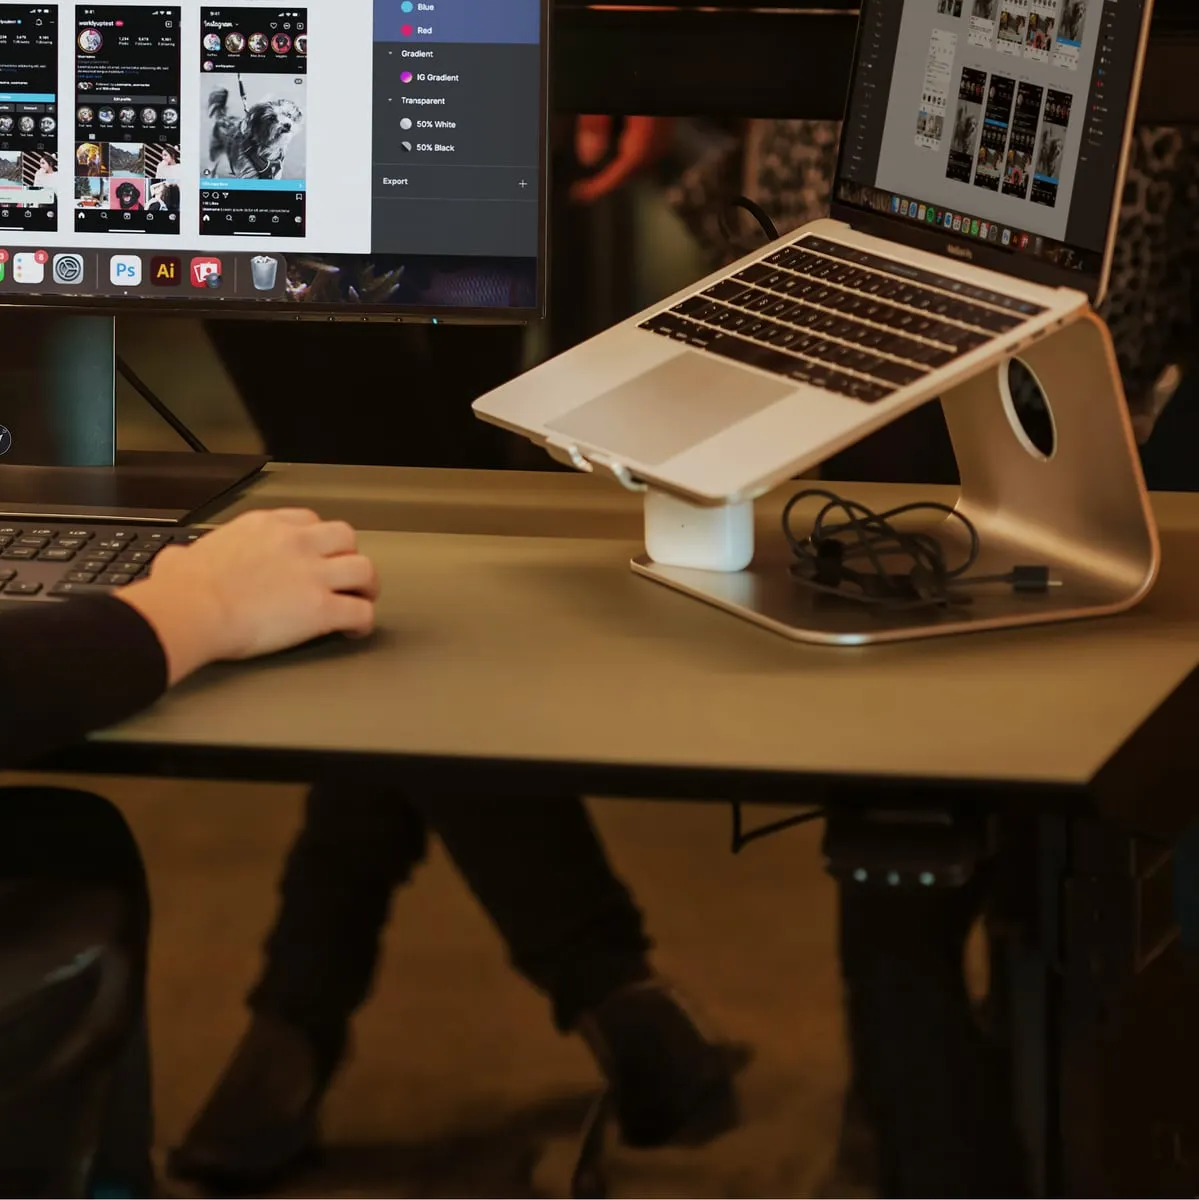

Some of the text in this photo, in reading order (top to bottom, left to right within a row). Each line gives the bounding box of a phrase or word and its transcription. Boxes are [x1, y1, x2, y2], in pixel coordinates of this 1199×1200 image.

[417, 3, 435, 11] Blue
[204, 20, 233, 29] Instagram
[417, 26, 433, 34] Red
[401, 50, 434, 58] Gradient
[417, 73, 459, 82] IG Gradient
[401, 97, 445, 106] Transparent
[416, 120, 456, 129] 50% White
[416, 143, 455, 152] 50% Black
[383, 178, 408, 186] Export
[116, 263, 135, 277] Ps
[156, 263, 175, 278] Ai
